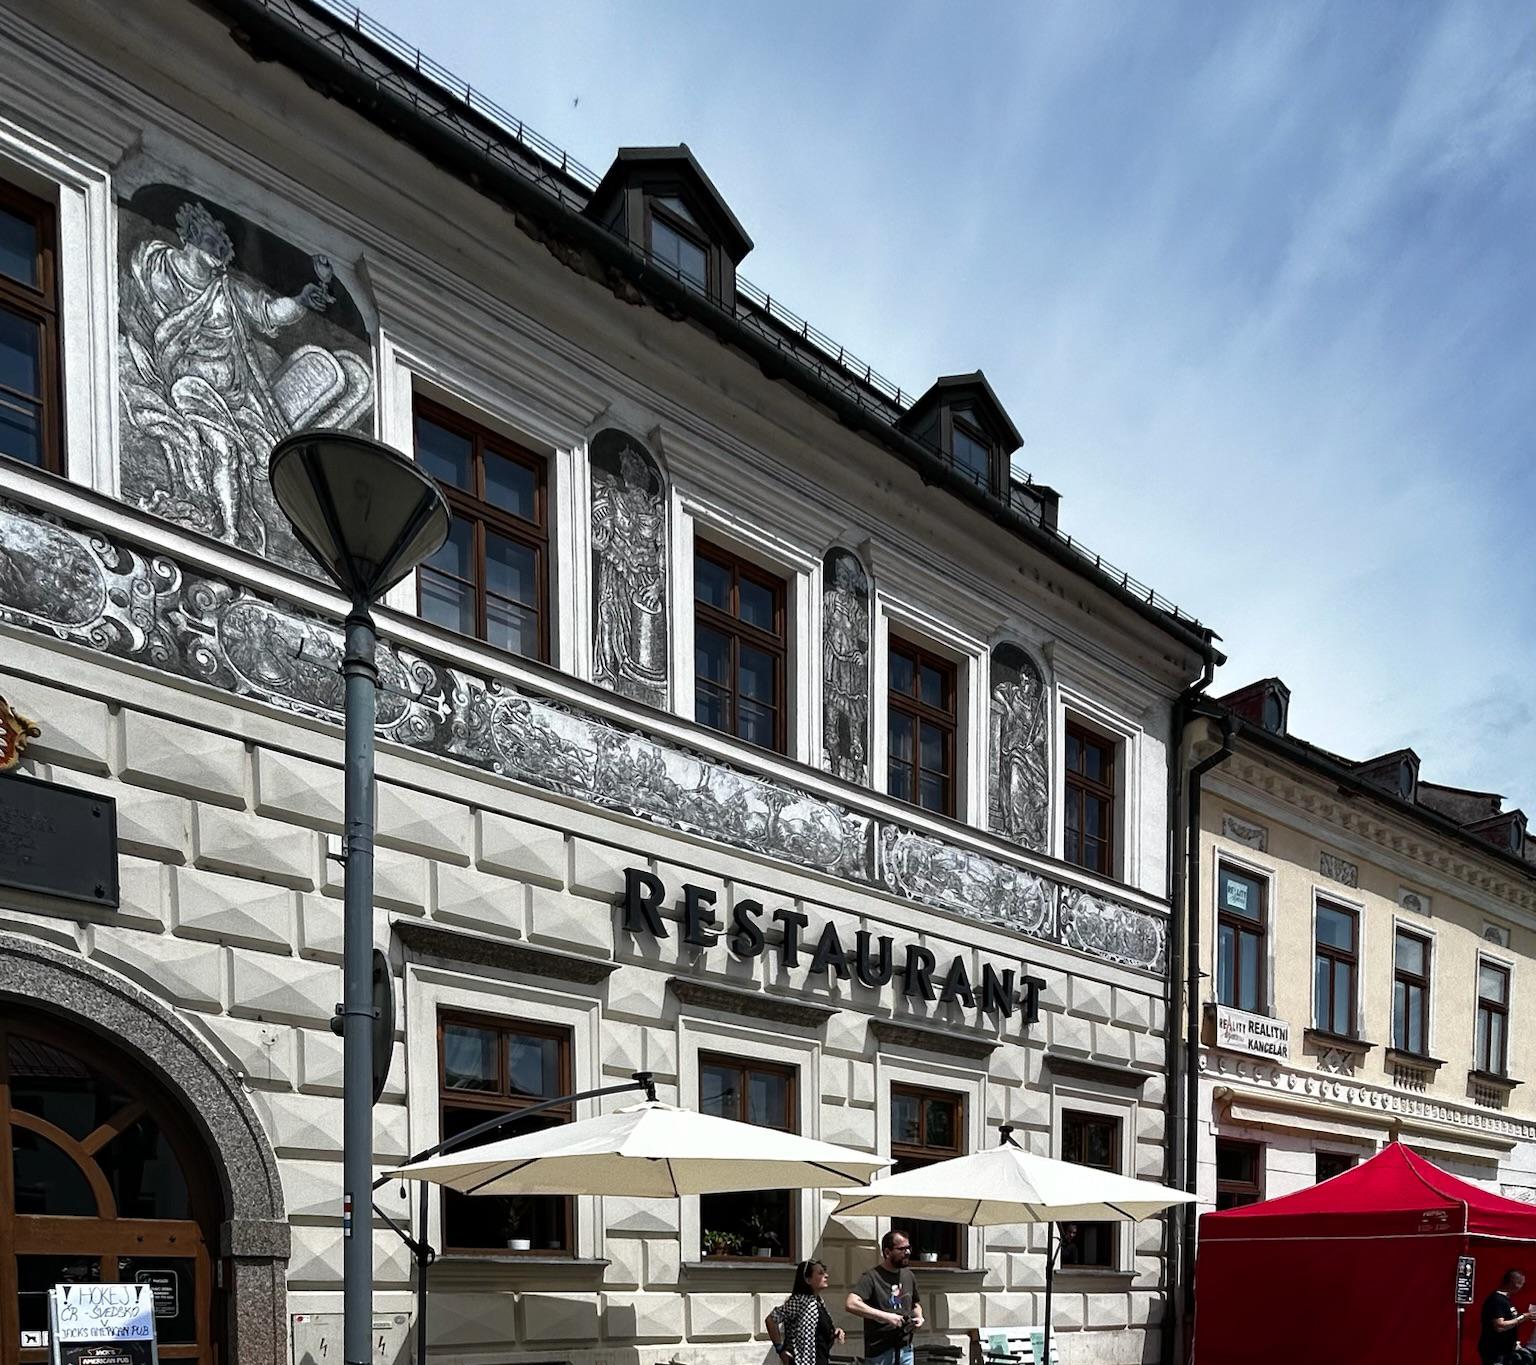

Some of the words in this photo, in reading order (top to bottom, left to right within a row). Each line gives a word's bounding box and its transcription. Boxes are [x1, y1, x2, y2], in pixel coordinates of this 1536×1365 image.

[622, 867, 1047, 1025] RESTAURANT
[79, 1286, 130, 1306] HOKEJ
[131, 1325, 149, 1336] PUB
[82, 1357, 116, 1365] AMERICAN
